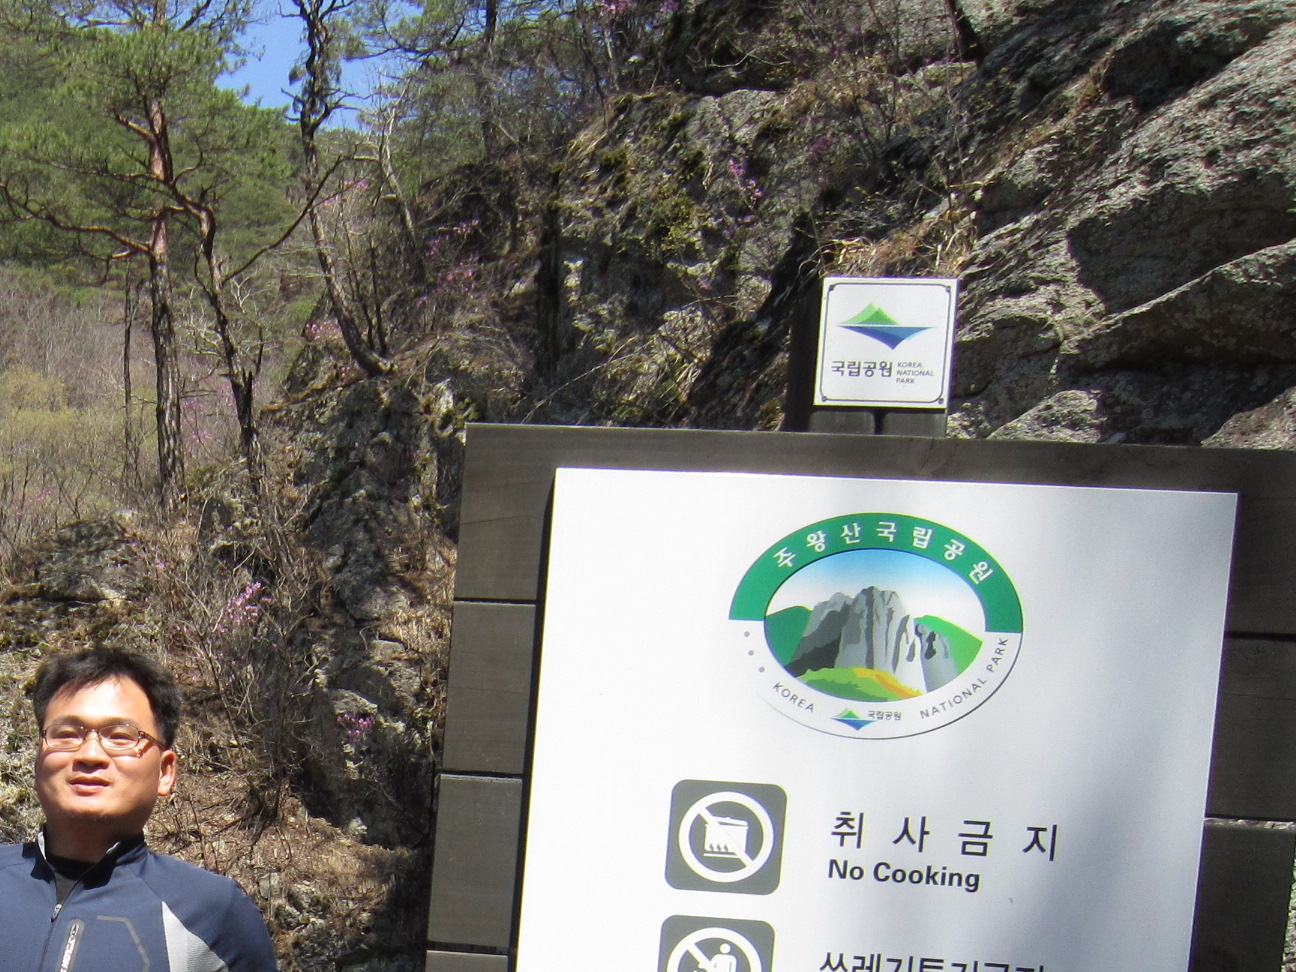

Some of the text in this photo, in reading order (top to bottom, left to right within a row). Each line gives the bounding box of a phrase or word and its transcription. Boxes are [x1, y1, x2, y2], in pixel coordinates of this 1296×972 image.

[831, 360, 893, 378] 국립공원
[896, 369, 935, 377] NATIONAL
[772, 520, 994, 585] 주왕산국립공원
[772, 636, 1009, 720] KOREA NATIONAL PARK
[867, 710, 902, 721] 국립공원
[828, 858, 981, 893] No Cooking
